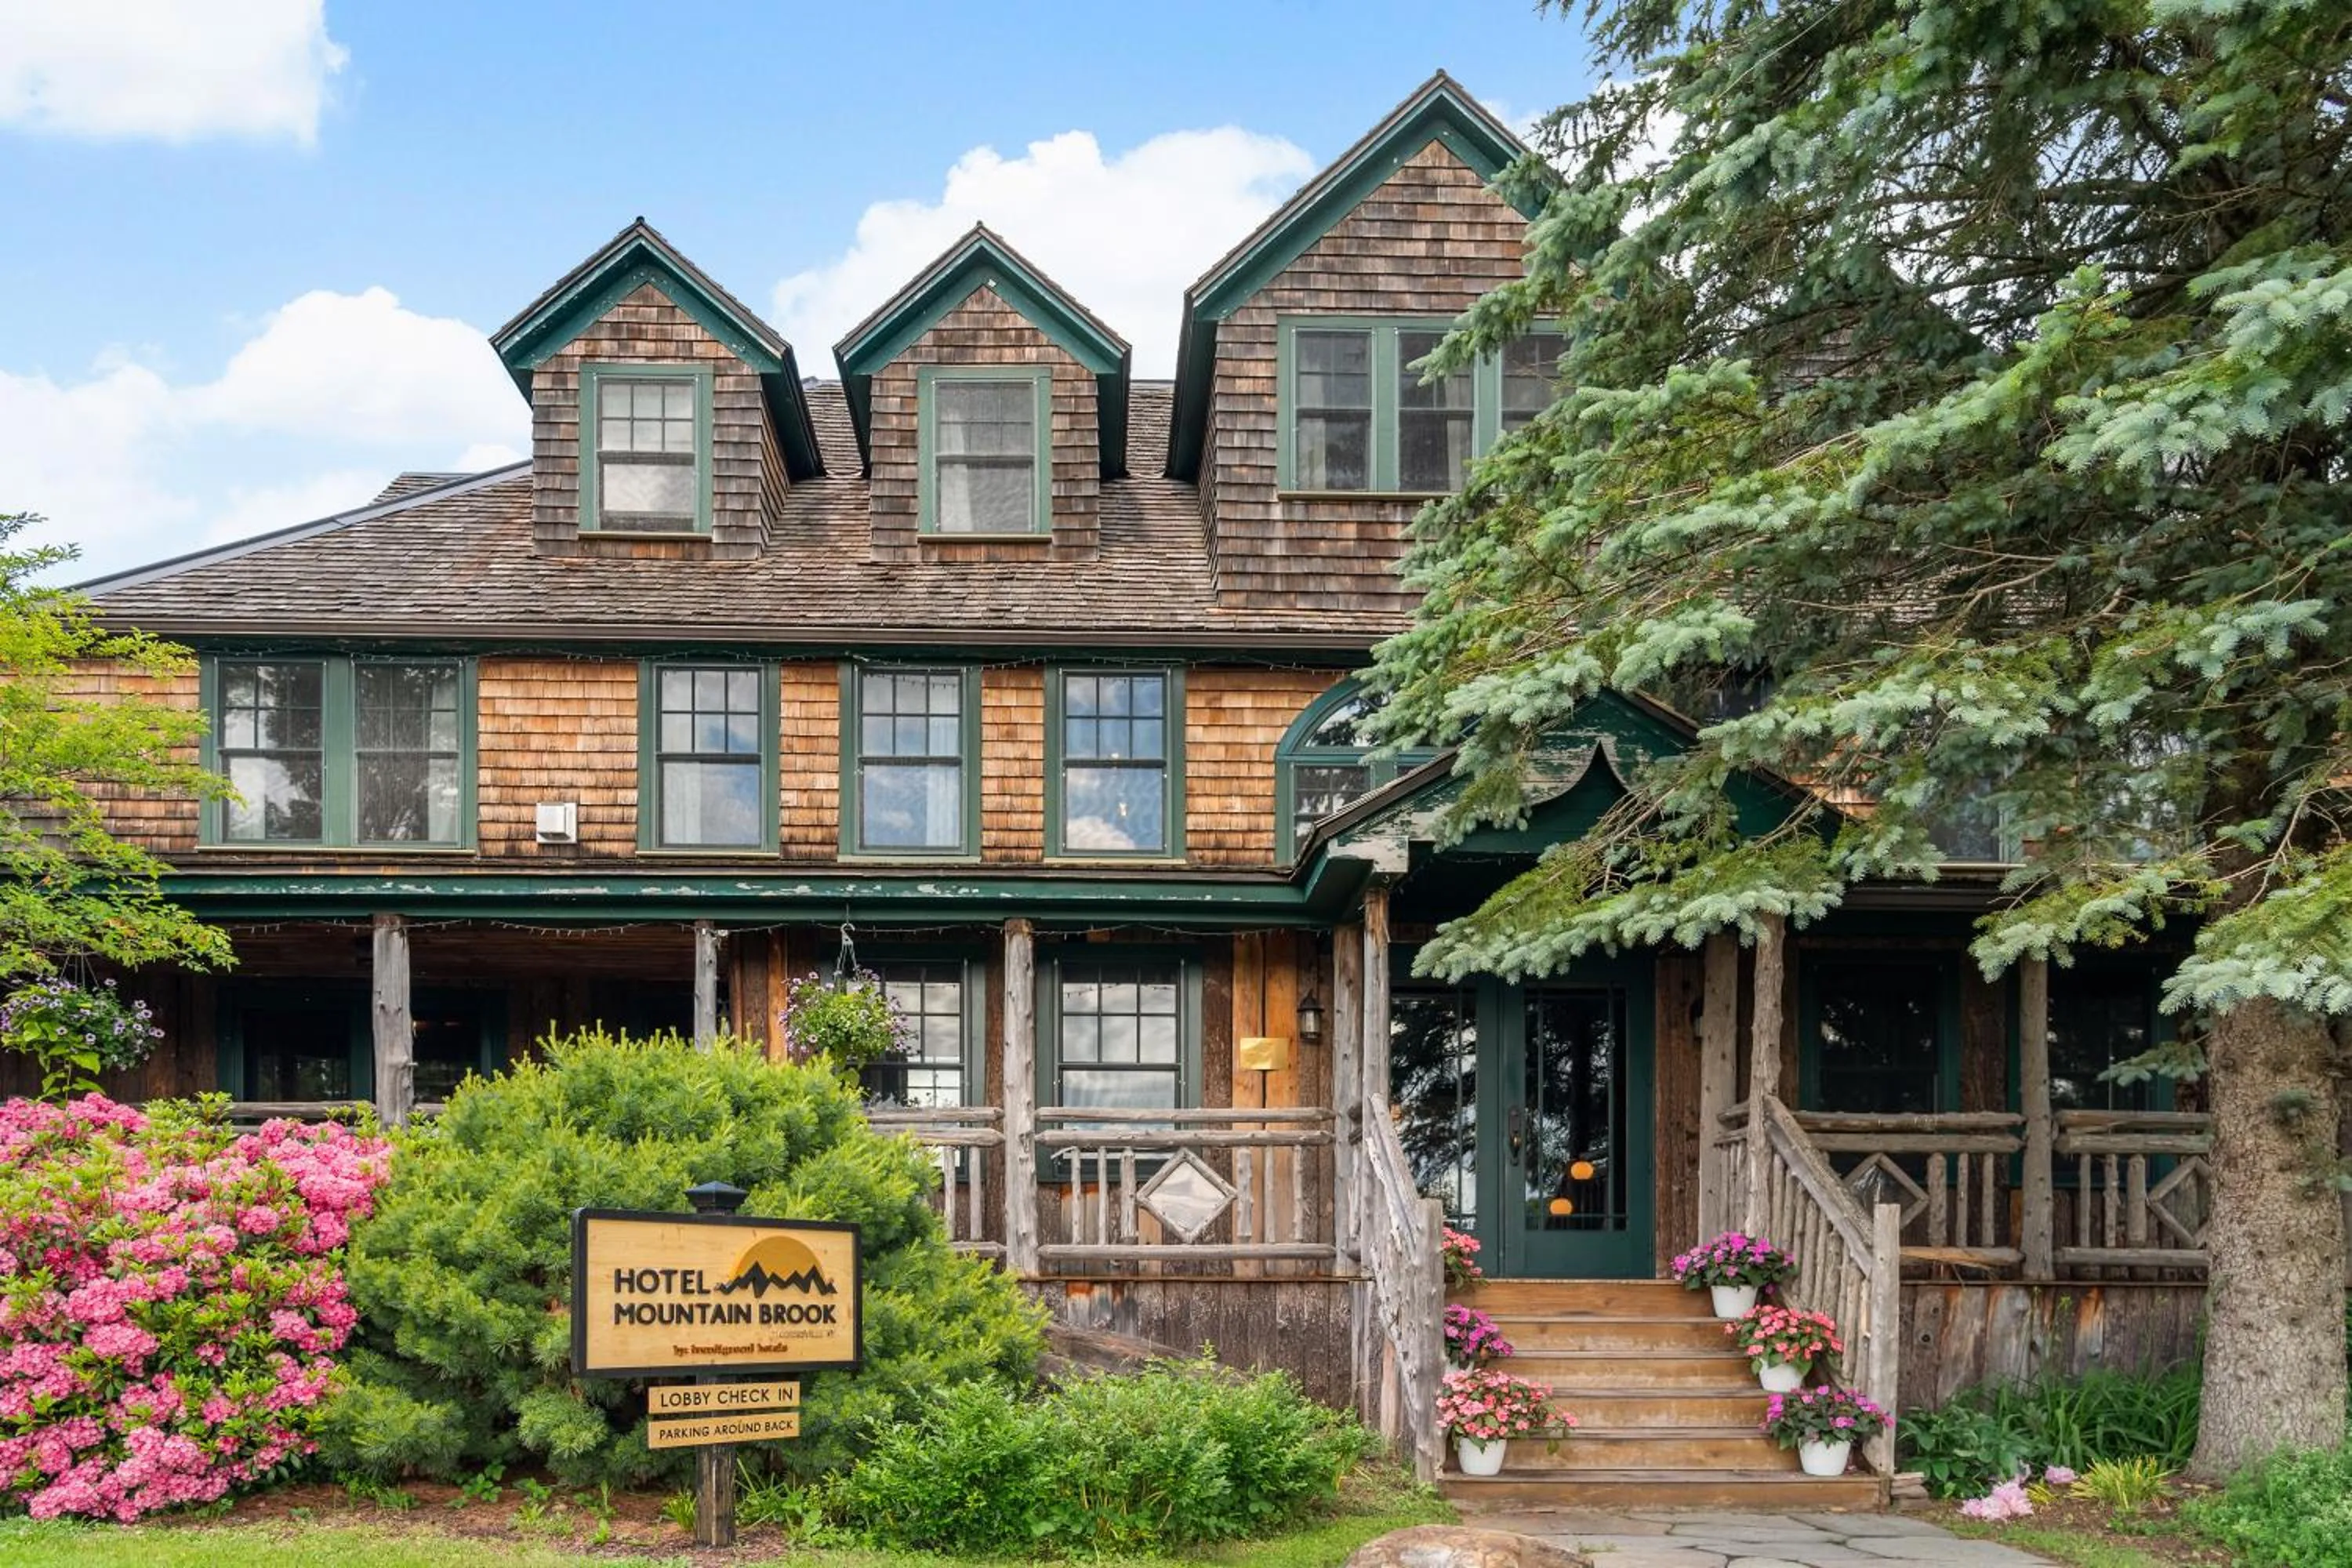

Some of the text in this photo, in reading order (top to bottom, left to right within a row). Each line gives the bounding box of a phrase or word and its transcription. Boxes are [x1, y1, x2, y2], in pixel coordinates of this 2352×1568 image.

[614, 1269, 711, 1294] HOTEL
[614, 1302, 837, 1325] MOUNTAIN BROOK
[661, 1388, 793, 1407] LOBBY CHECK IN
[659, 1420, 793, 1439] PARKING AROUND BACK
